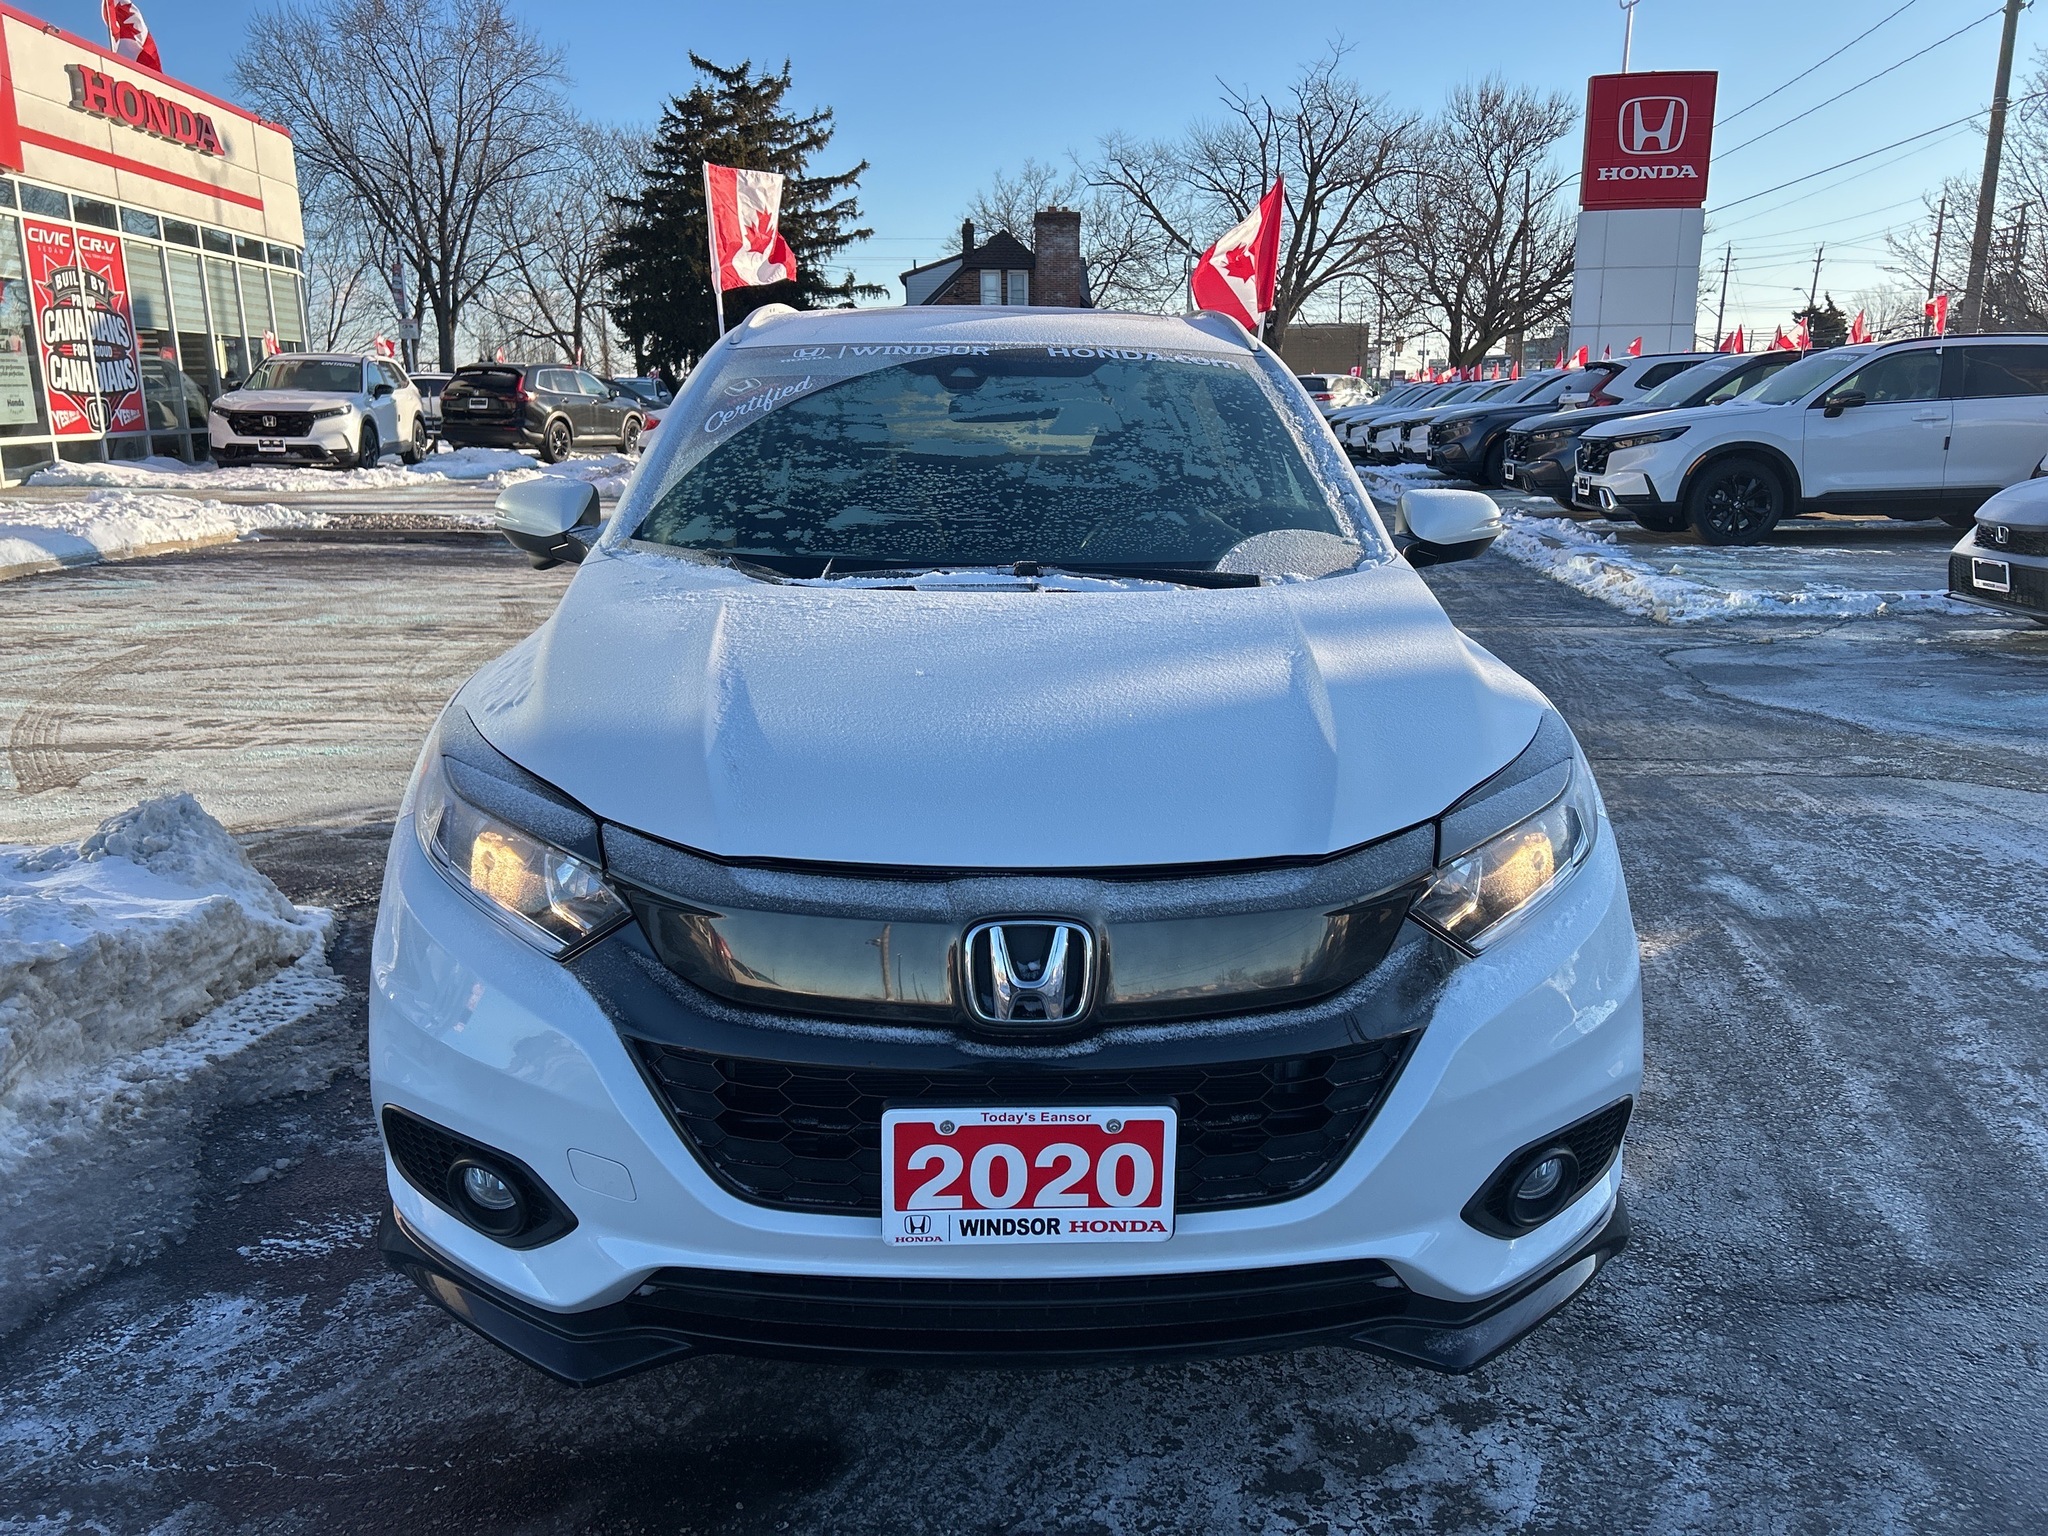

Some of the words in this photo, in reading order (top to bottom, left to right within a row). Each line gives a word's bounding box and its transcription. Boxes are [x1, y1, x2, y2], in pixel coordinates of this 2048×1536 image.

[77, 64, 225, 156] HONDA
[1597, 164, 1698, 181] HONDA
[27, 226, 71, 248] CIVIC
[79, 236, 116, 255] CR-V
[37, 245, 64, 255] SEDAN
[89, 275, 105, 295] BY
[71, 293, 96, 309] PRUD
[44, 308, 130, 349] CANADIANS
[72, 343, 88, 357] FOR
[92, 344, 113, 358] ROUD
[850, 345, 991, 357] WINDSOR
[49, 354, 137, 394] CANADIANS
[704, 375, 813, 433] Certified
[980, 1112, 1036, 1124] Today's
[1041, 1112, 1092, 1123] Eansor
[906, 1142, 1155, 1210] 2020
[959, 1217, 1061, 1237] WINDSOR
[1068, 1220, 1168, 1233] HONDA
